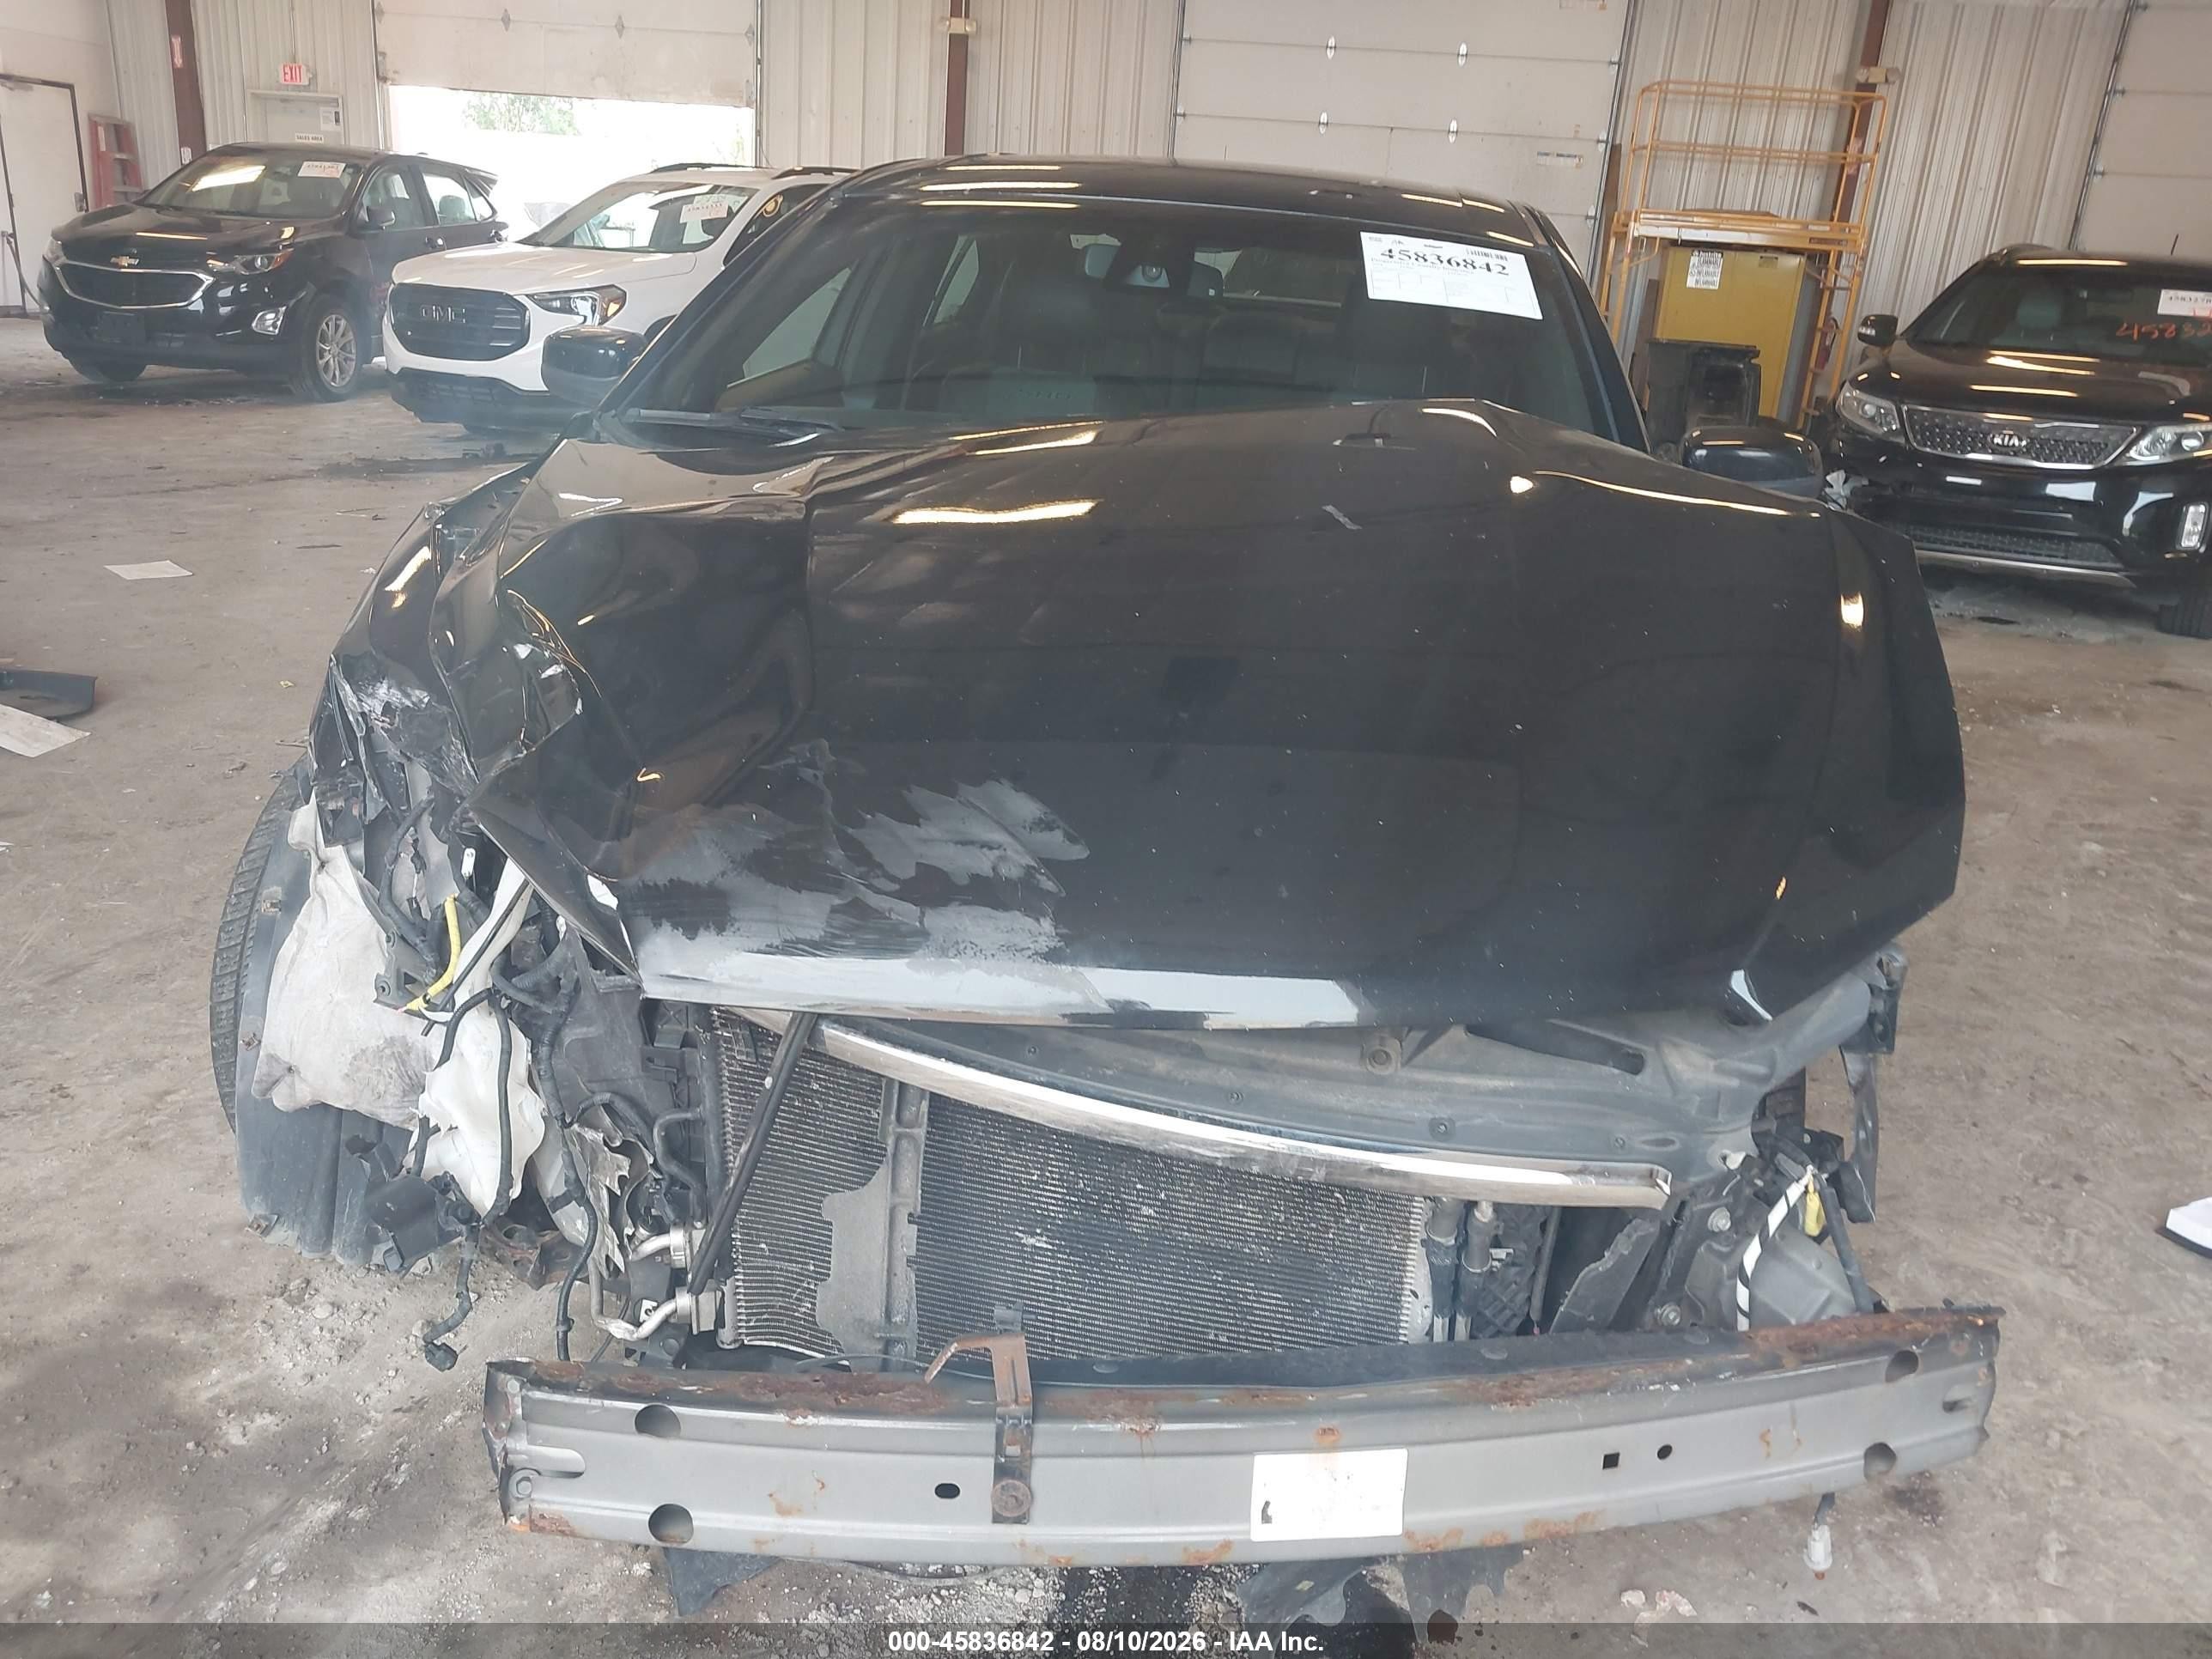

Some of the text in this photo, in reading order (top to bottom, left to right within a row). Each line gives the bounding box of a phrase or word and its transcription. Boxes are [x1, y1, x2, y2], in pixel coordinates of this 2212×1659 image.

[283, 64, 302, 83] EXIT
[1381, 248, 1510, 276] 45836842
[420, 304, 465, 323] GMC
[1993, 433, 2020, 447] KIA
